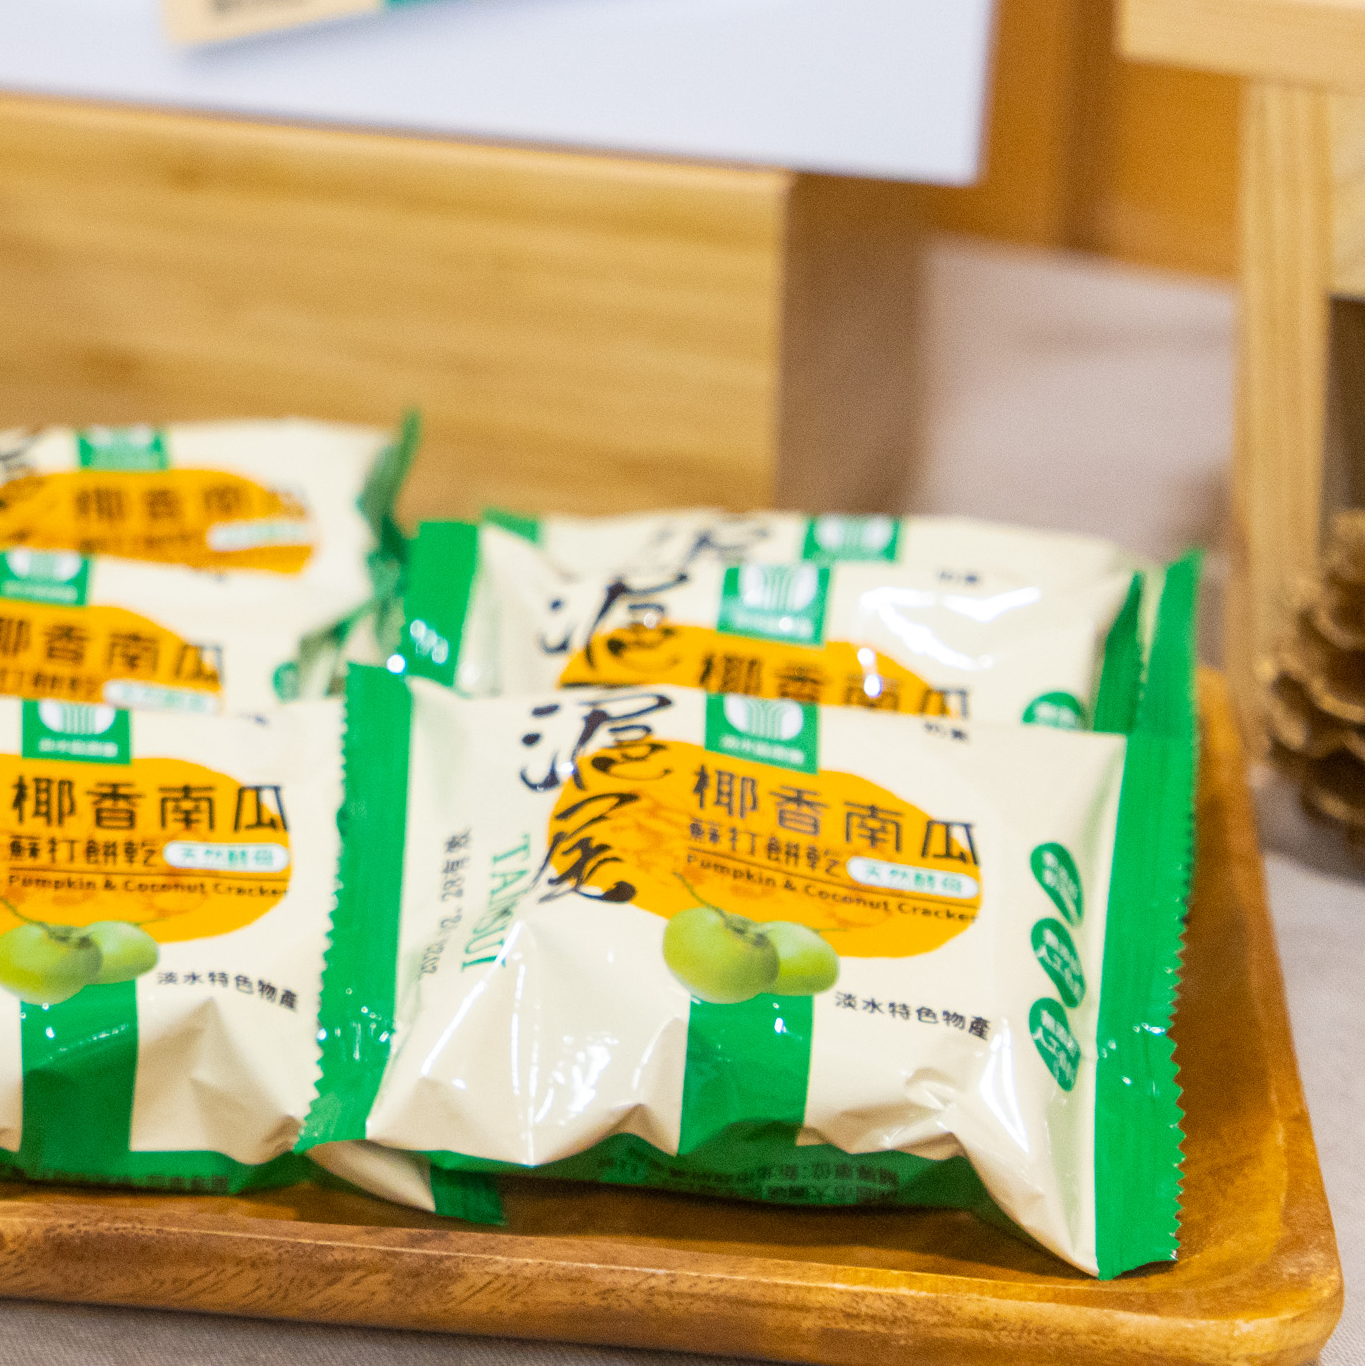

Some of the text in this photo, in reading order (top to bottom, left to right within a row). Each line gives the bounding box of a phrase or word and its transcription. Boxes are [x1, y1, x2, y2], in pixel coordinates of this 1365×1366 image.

[11, 774, 290, 833] 椰香南瓜
[692, 764, 981, 867] 椰香南瓜
[9, 834, 159, 867] 蘇打餅乾
[689, 816, 843, 879] 蘇打餅乾
[7, 874, 97, 894] Pumpkin
[104, 879, 117, 893] &
[123, 879, 207, 896] Coconut
[687, 854, 777, 891] Pumpkin
[783, 879, 798, 891] &
[804, 884, 891, 913] Coconut
[156, 970, 299, 1013] 淡水特色物產
[834, 990, 991, 1041] 淡水特色物產
